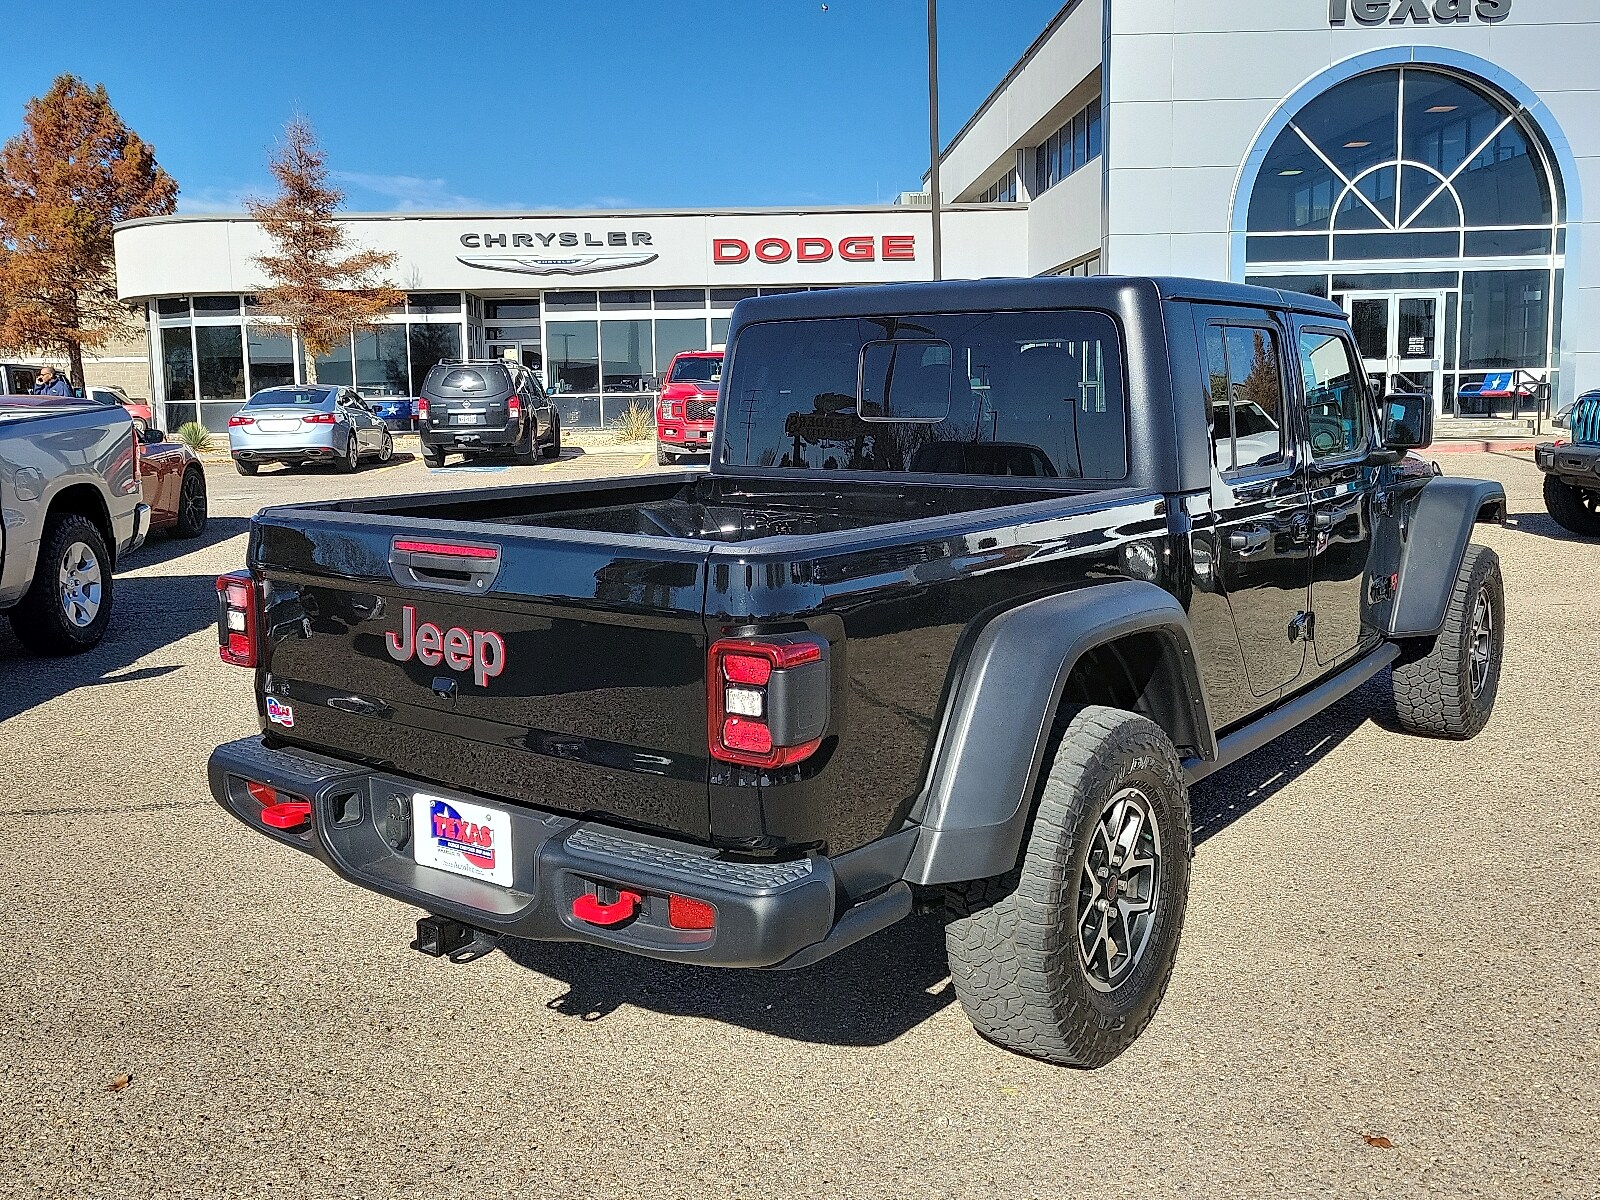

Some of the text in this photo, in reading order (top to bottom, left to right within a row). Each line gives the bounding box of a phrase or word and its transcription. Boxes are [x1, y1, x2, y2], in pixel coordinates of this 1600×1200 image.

[459, 231, 654, 248] CHRYSLER
[712, 235, 916, 265] DODGE
[385, 605, 506, 688] Jeep
[433, 814, 492, 848] TEXAS
